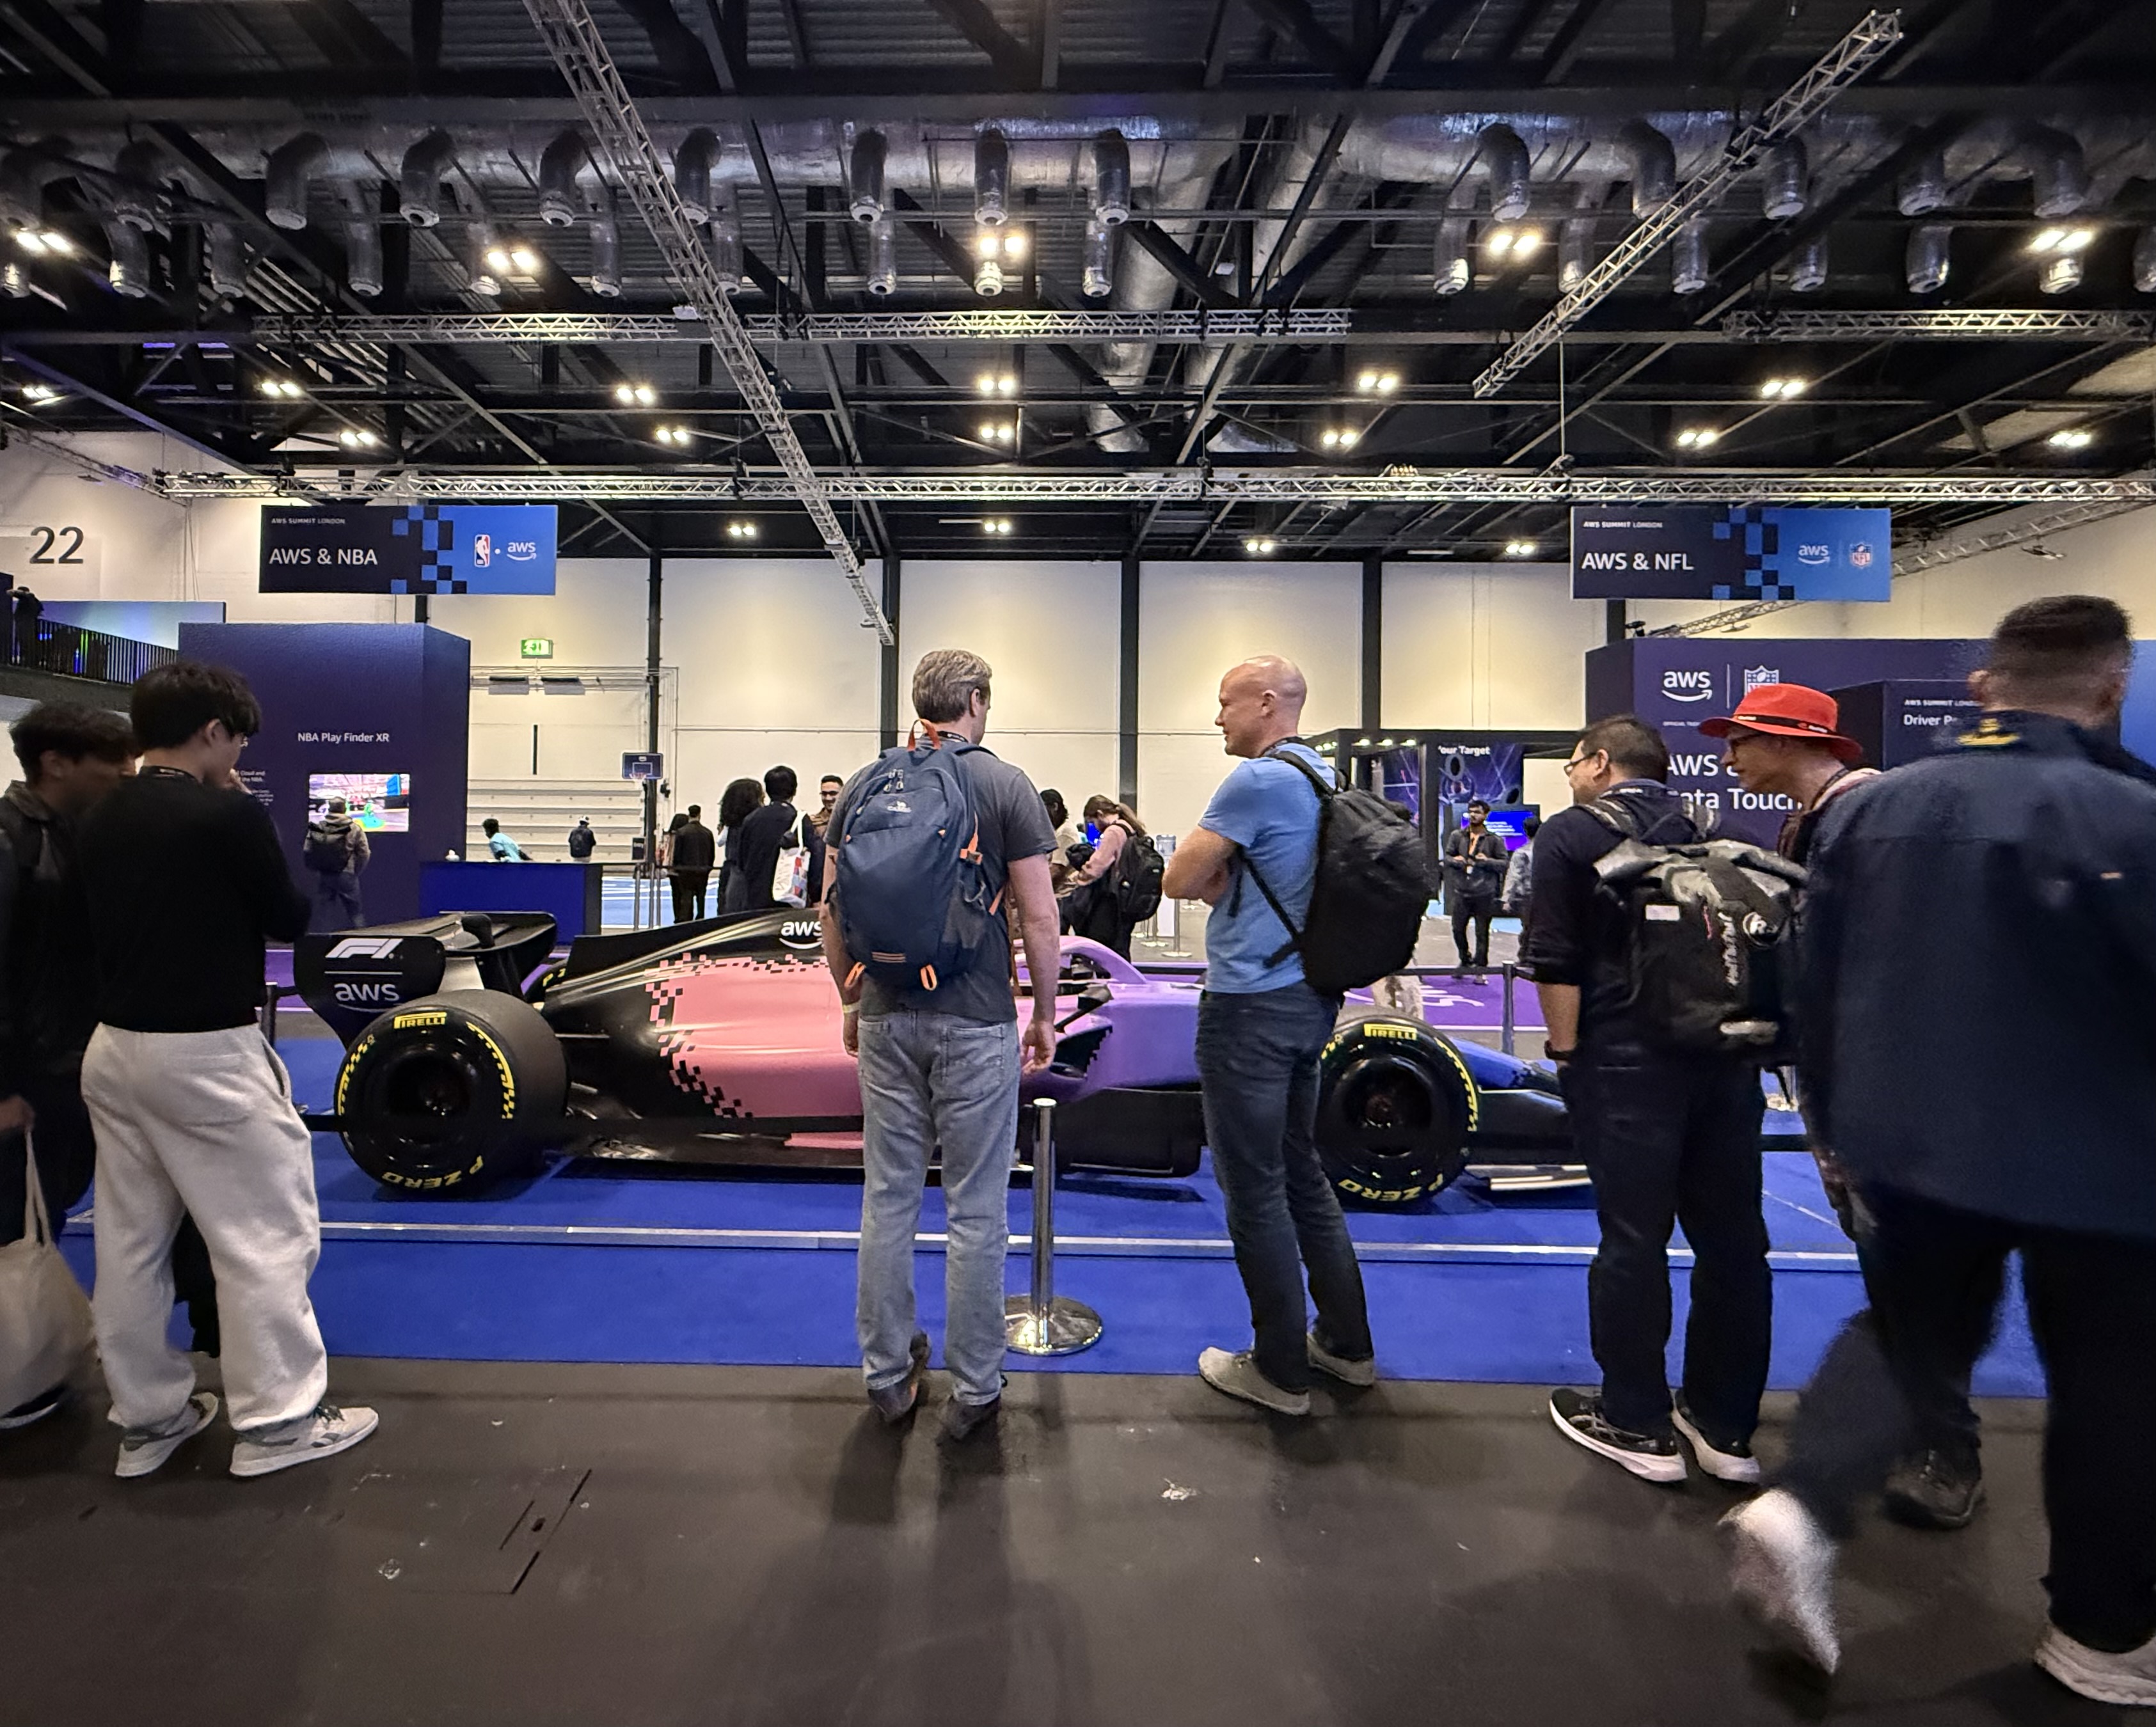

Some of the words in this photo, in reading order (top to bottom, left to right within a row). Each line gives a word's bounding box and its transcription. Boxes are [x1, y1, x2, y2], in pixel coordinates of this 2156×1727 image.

[29, 526, 84, 564] 22
[269, 548, 311, 565] AWS
[317, 548, 331, 565] &
[338, 549, 378, 565] NBA
[1581, 553, 1627, 571] AWS
[1633, 553, 1649, 571] &
[1656, 553, 1694, 571] NFL
[1663, 672, 1711, 688] aws
[1903, 714, 1940, 725] Driver
[297, 732, 319, 742] NBA
[321, 732, 342, 744] Play
[344, 732, 374, 743] Finder
[376, 733, 390, 742] XR
[1438, 745, 1457, 754] our
[1459, 745, 1491, 756] Target
[325, 938, 404, 958] F1
[334, 983, 399, 1001] aws
[394, 1012, 447, 1029] PIRELLI
[1364, 1023, 1417, 1040] PIRELLI
[382, 1171, 462, 1188] ZERO
[1338, 1179, 1422, 1201] ZERO
